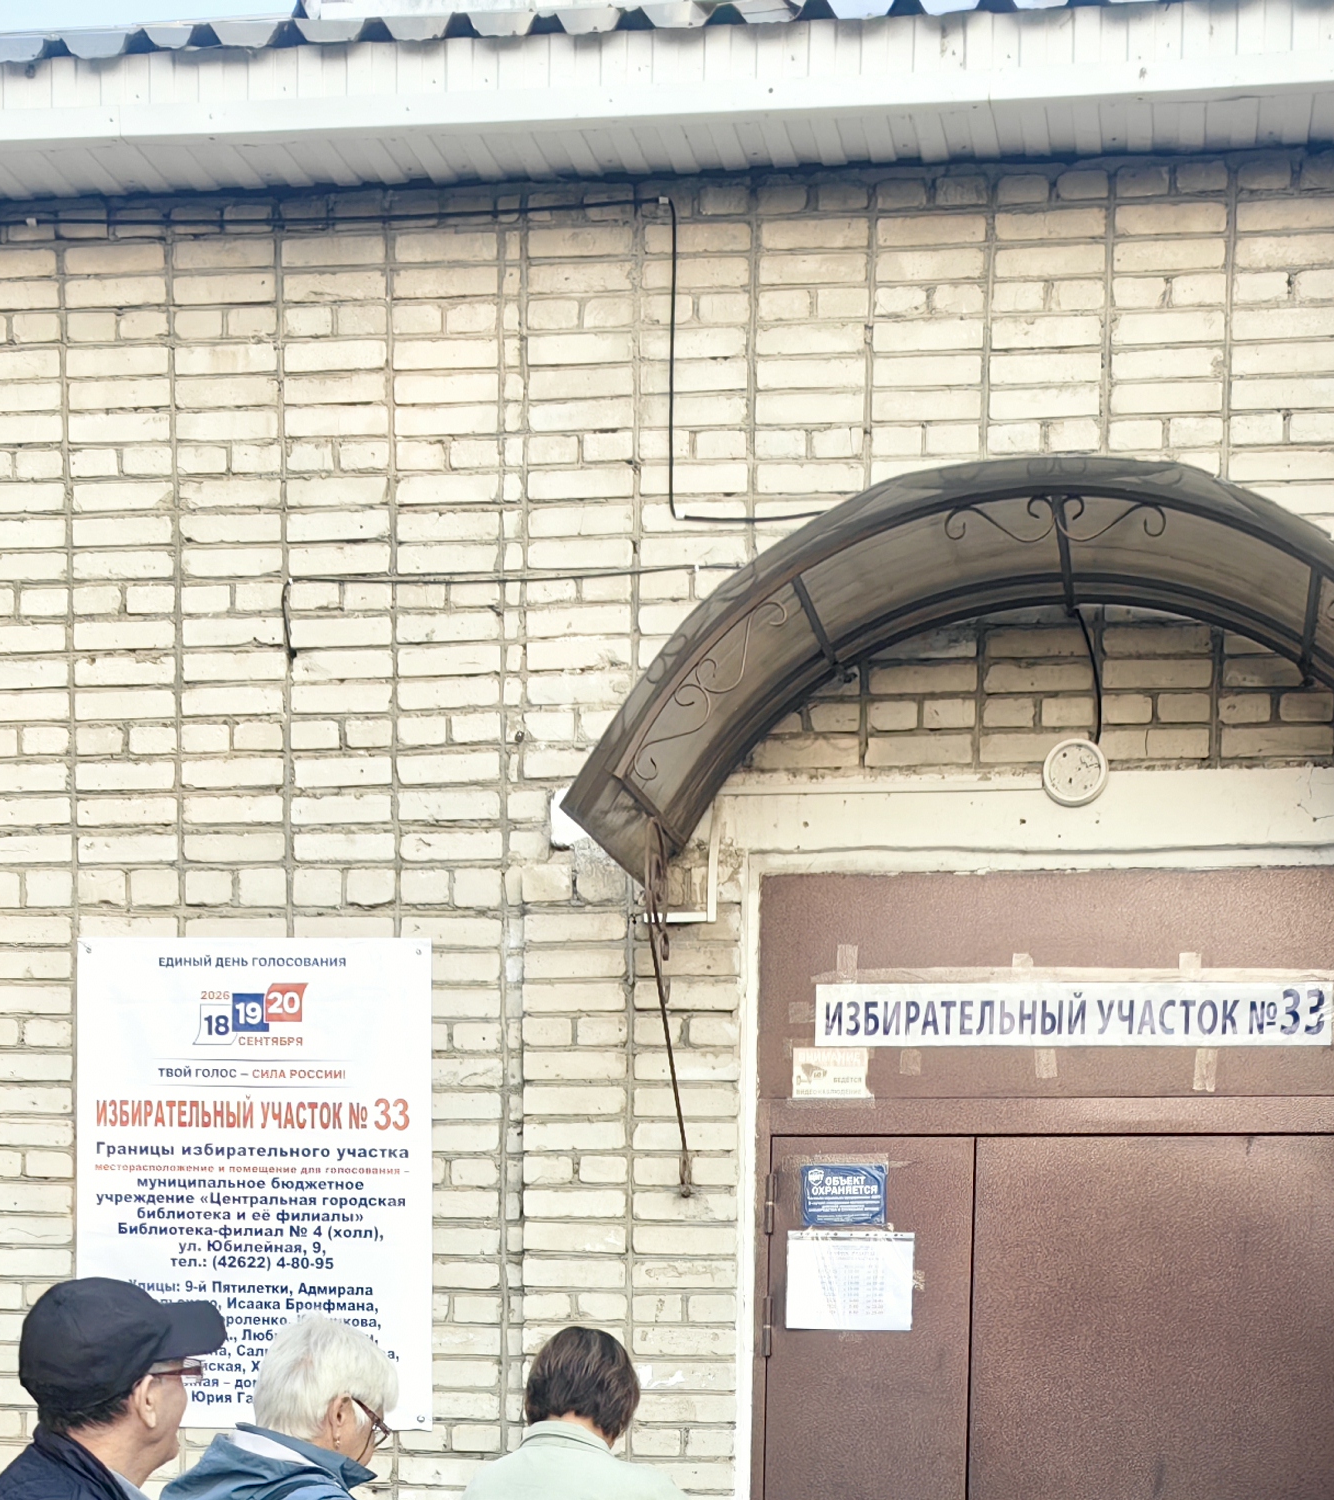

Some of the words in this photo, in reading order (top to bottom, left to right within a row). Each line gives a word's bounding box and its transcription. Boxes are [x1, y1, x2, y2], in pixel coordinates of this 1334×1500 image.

[158, 955, 212, 968] ЕДИНЫЙ
[215, 957, 248, 968] ДЕНЬ
[252, 957, 347, 968] ГОЛОСОВАНИЯ
[201, 991, 230, 1000] 2026
[204, 1014, 229, 1036] 18
[235, 1002, 262, 1024] 19
[267, 991, 301, 1014] 20
[824, 992, 1086, 1036] ИЗБИРАТЕЛЬНЫЙ
[1097, 999, 1240, 1036] УЧАСТОК
[238, 1036, 303, 1046] СЕНТЯБРЯ
[158, 1066, 192, 1078] ТВОЙ
[195, 1069, 237, 1078] ГОЛОС
[252, 1069, 286, 1079] СИЛА
[290, 1069, 346, 1080] РОССИИ!
[96, 1094, 254, 1129] ИЗБИРАТЕЛЬНЫЙ
[261, 1101, 343, 1130] УЧАСТОК
[349, 1102, 367, 1130] №
[374, 1098, 410, 1131] 33
[96, 1141, 174, 1158] Границы
[182, 1143, 330, 1160] избирательного
[337, 1147, 409, 1161] участка
[95, 1163, 215, 1173] месторасположение
[218, 1164, 225, 1172] и
[229, 1165, 297, 1175] помещение
[325, 1167, 401, 1175] голосования
[137, 1177, 266, 1190] муниципальное
[271, 1177, 364, 1192] бюджетное
[824, 1176, 866, 1186] ОБЪЕКТ
[811, 1185, 878, 1195] ОХРАНЯЕТСЯ
[96, 1193, 195, 1205] учреждение
[200, 1192, 317, 1207] «Центральная
[322, 1197, 406, 1209] городская
[137, 1207, 231, 1220] библиотека
[236, 1211, 246, 1220] и
[252, 1209, 271, 1221] её
[276, 1209, 364, 1224] филиалы»
[118, 1222, 284, 1239] Библиотека-филиал
[289, 1225, 308, 1237] №
[313, 1225, 323, 1237] 4
[328, 1225, 384, 1242] (холл),
[178, 1242, 202, 1254] ул.
[207, 1240, 307, 1256] Юбилейная,
[312, 1241, 326, 1256] 9,
[170, 1256, 207, 1267] тел.:
[212, 1255, 271, 1271] (42622)
[276, 1256, 334, 1270] 4-80-95
[185, 1280, 207, 1293] 9-й
[212, 1281, 293, 1296] Пятилетки,
[298, 1282, 373, 1298] Адмирала
[227, 1297, 280, 1309] Исаака
[286, 1298, 379, 1314] Бронфмана,
[191, 1390, 232, 1405] Юрия
